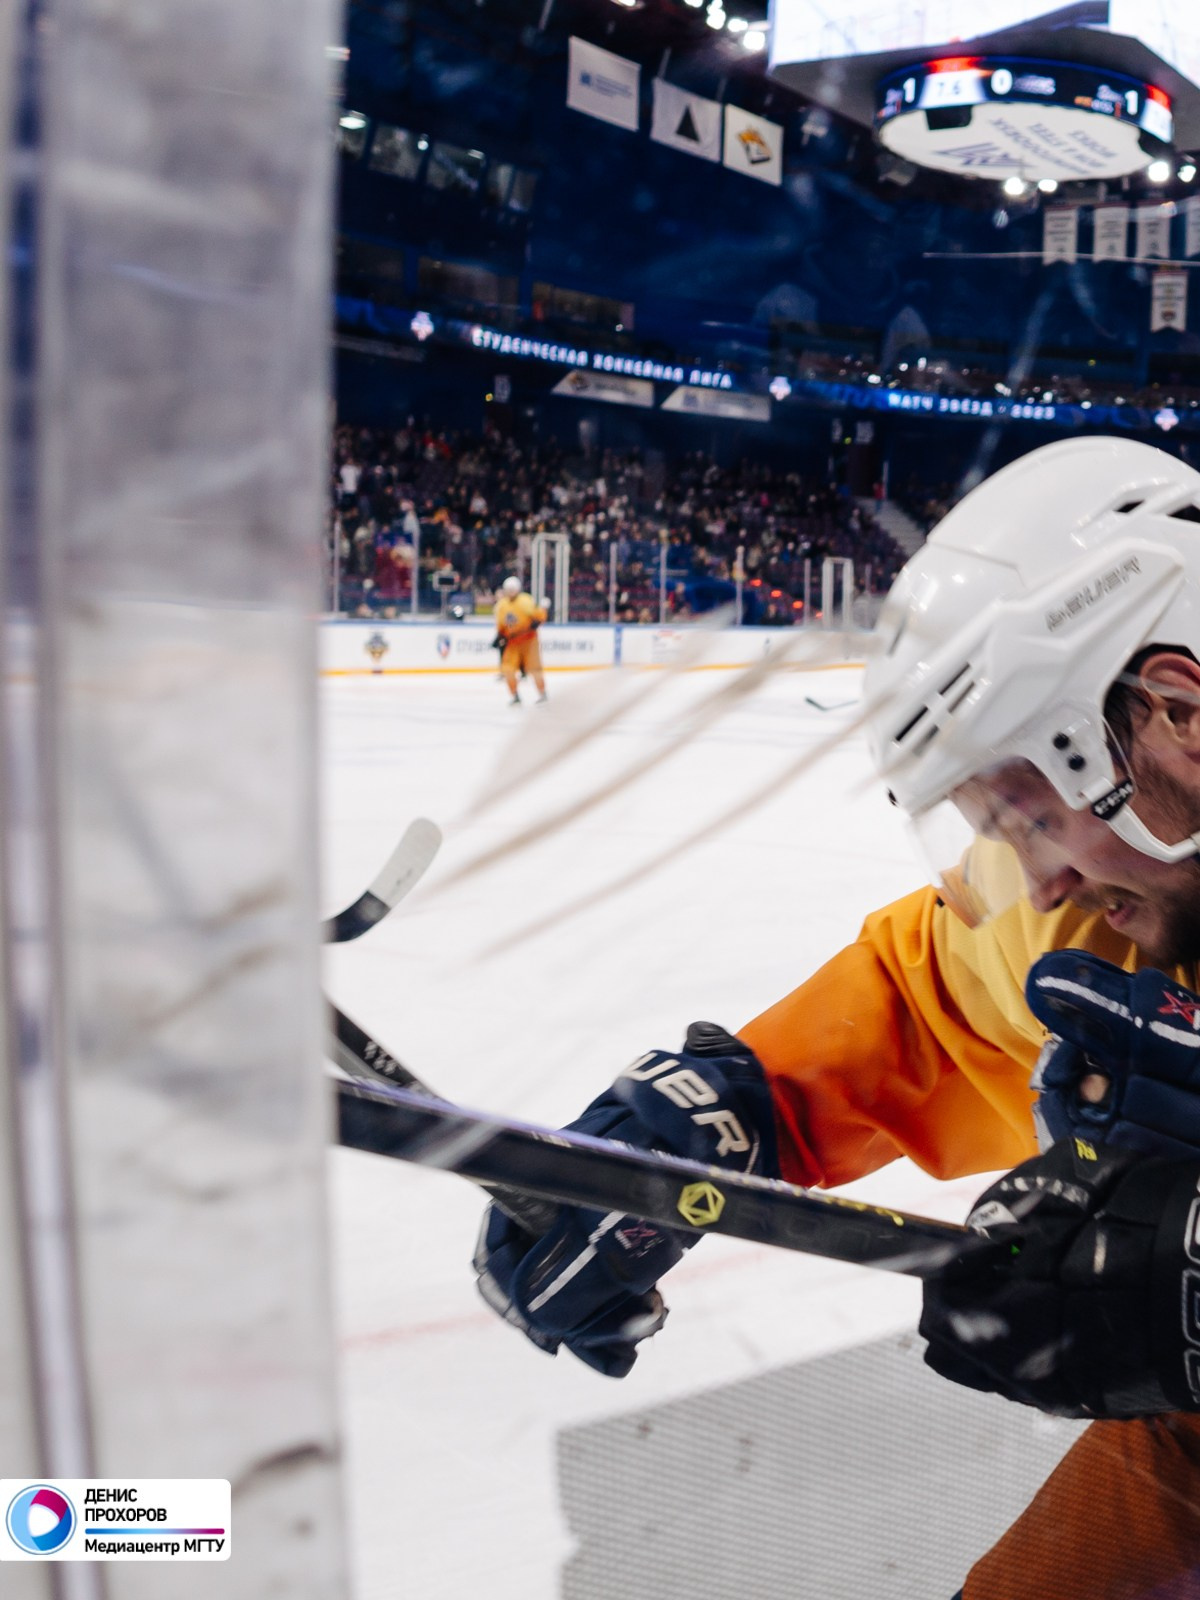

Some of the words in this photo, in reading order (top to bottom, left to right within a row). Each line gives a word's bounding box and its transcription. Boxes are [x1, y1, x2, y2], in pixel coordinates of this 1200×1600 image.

[1124, 90, 1138, 115] 1
[472, 327, 588, 366] СТУДЕНЧЕСКАЯ
[593, 354, 684, 383] ХОККЕЙНАЯ
[689, 369, 732, 389] ЛИГА
[888, 393, 933, 410] МАТЧ
